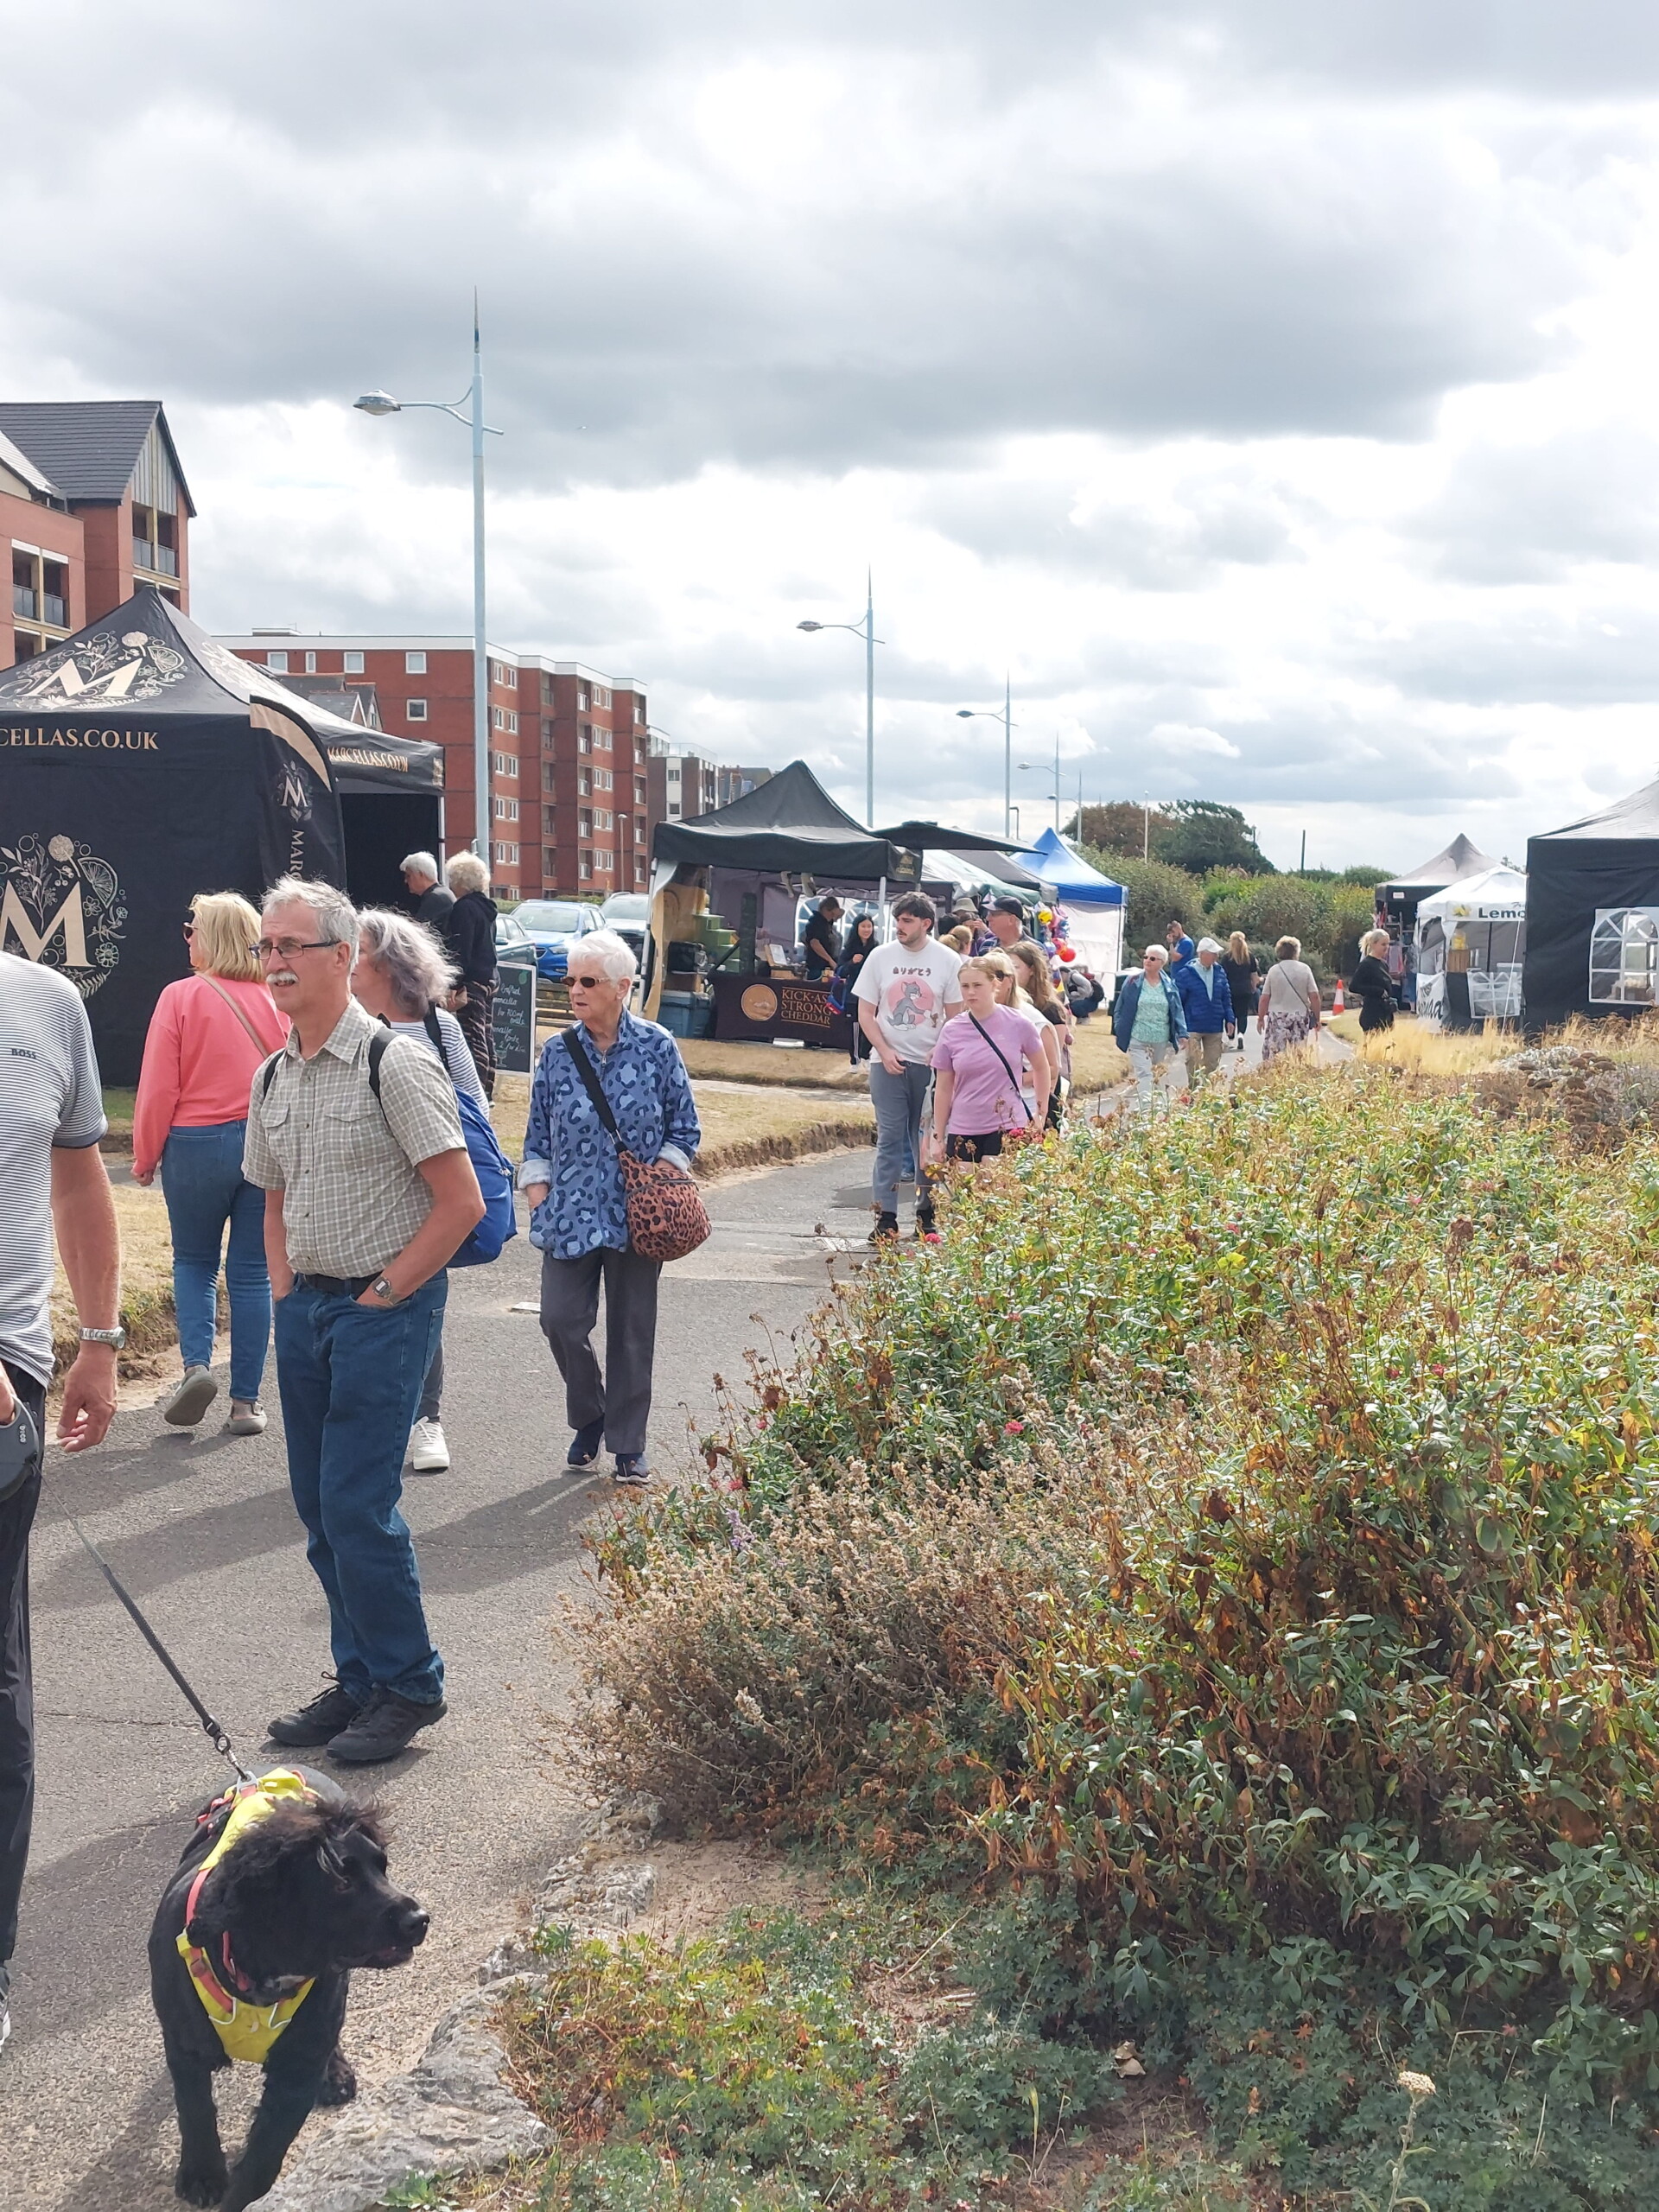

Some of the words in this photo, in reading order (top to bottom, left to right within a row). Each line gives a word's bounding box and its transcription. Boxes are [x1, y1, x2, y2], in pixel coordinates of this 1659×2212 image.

[1478, 907, 1526, 918] Lemo
[781, 1000, 832, 1016] STRONG
[781, 1010, 830, 1025] CHEDDAR
[11, 1048, 37, 1059] BOSS
